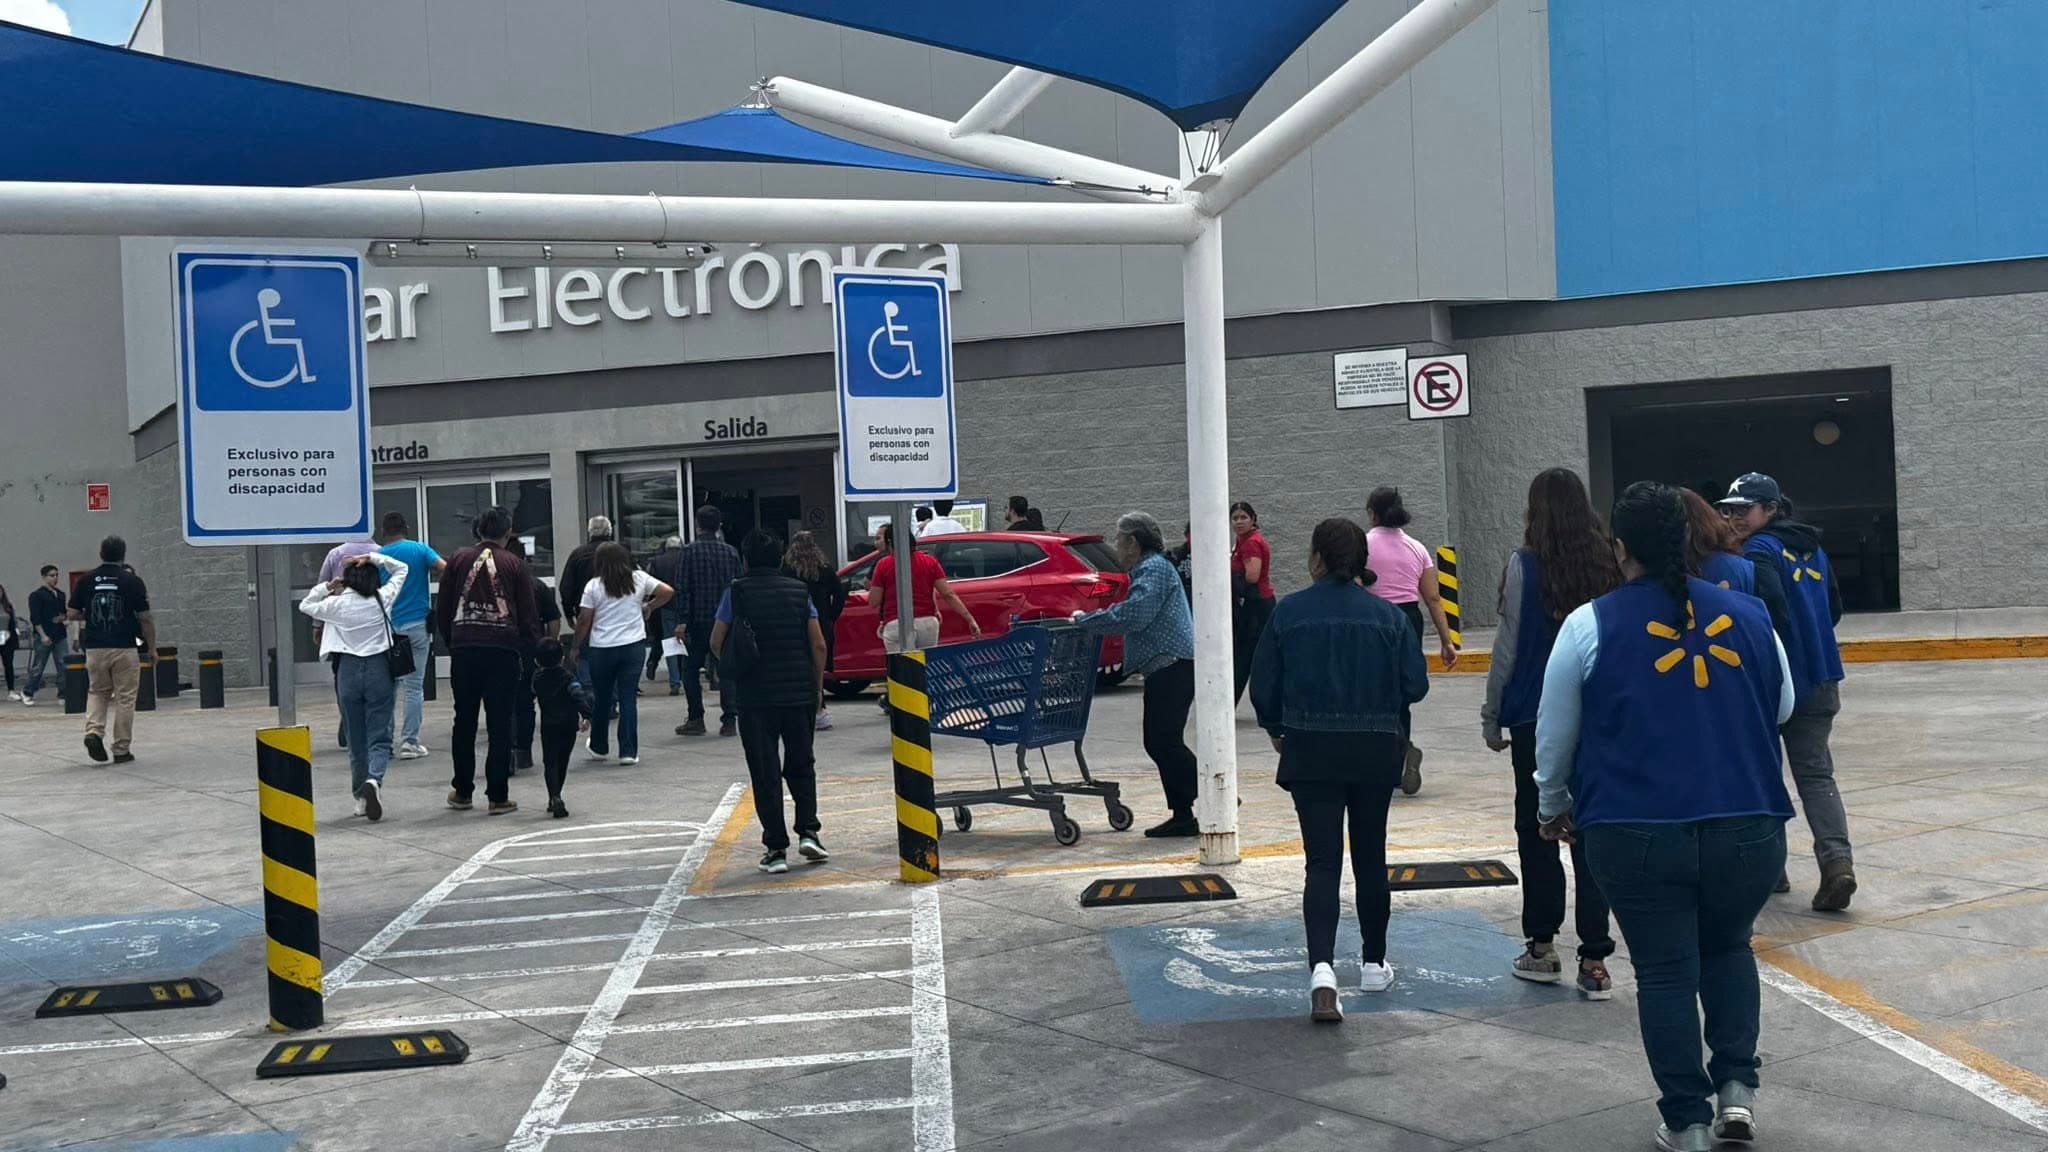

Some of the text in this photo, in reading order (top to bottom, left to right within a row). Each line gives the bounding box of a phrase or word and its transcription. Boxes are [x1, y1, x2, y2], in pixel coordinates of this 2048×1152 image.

[364, 283, 428, 341] ar
[704, 416, 768, 440] Salida
[868, 425, 934, 436] Exclusivo para
[371, 440, 429, 462] trada
[869, 440, 930, 450] personas con
[227, 447, 336, 462] Exclusivo para
[869, 452, 929, 463] discapacidad
[228, 467, 328, 480] personas con
[228, 482, 326, 496] discapacidad
